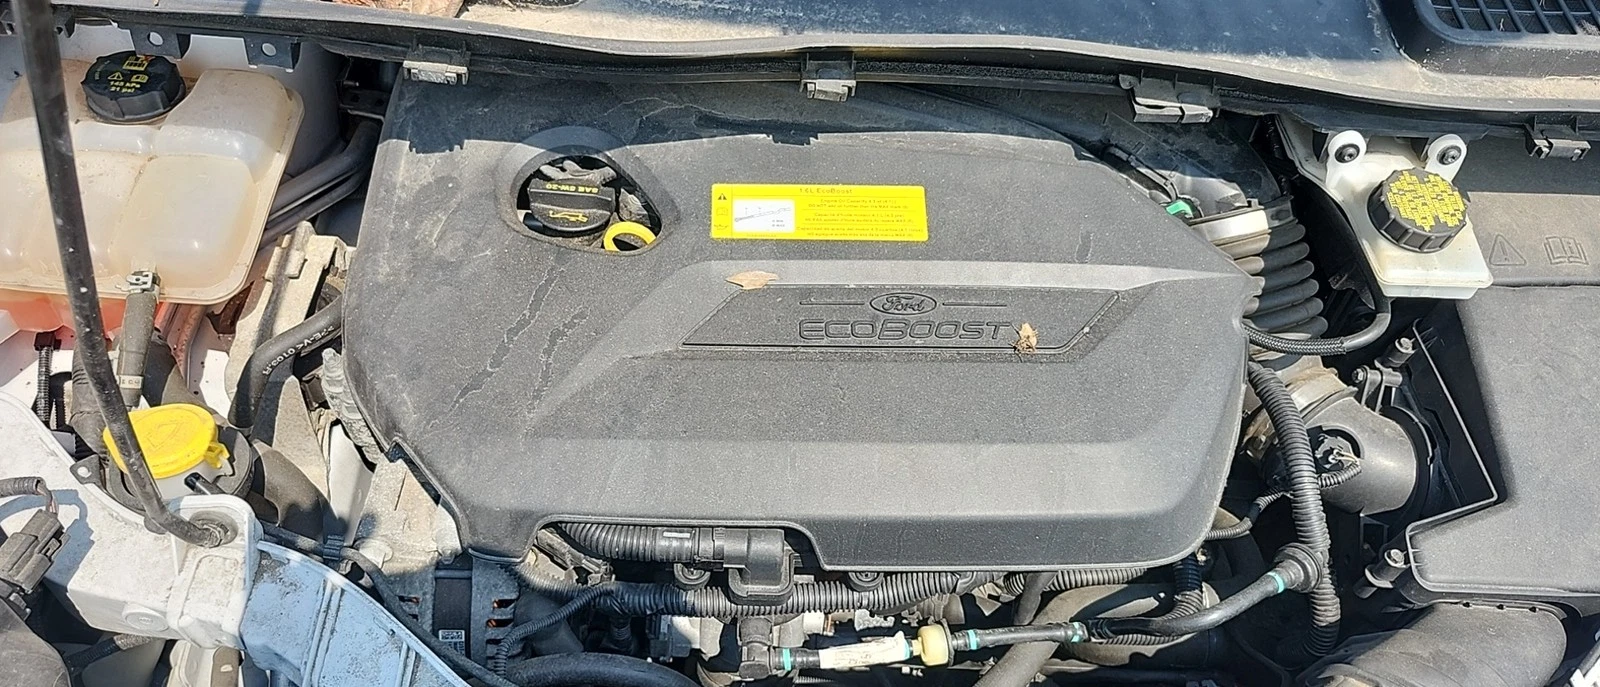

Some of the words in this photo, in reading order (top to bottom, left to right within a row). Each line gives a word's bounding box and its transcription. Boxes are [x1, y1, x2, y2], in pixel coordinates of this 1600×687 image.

[545, 183, 576, 192] 5W-20
[577, 186, 599, 194] SAE
[881, 294, 926, 312] Ford
[798, 318, 1012, 341] ECOBOOST
